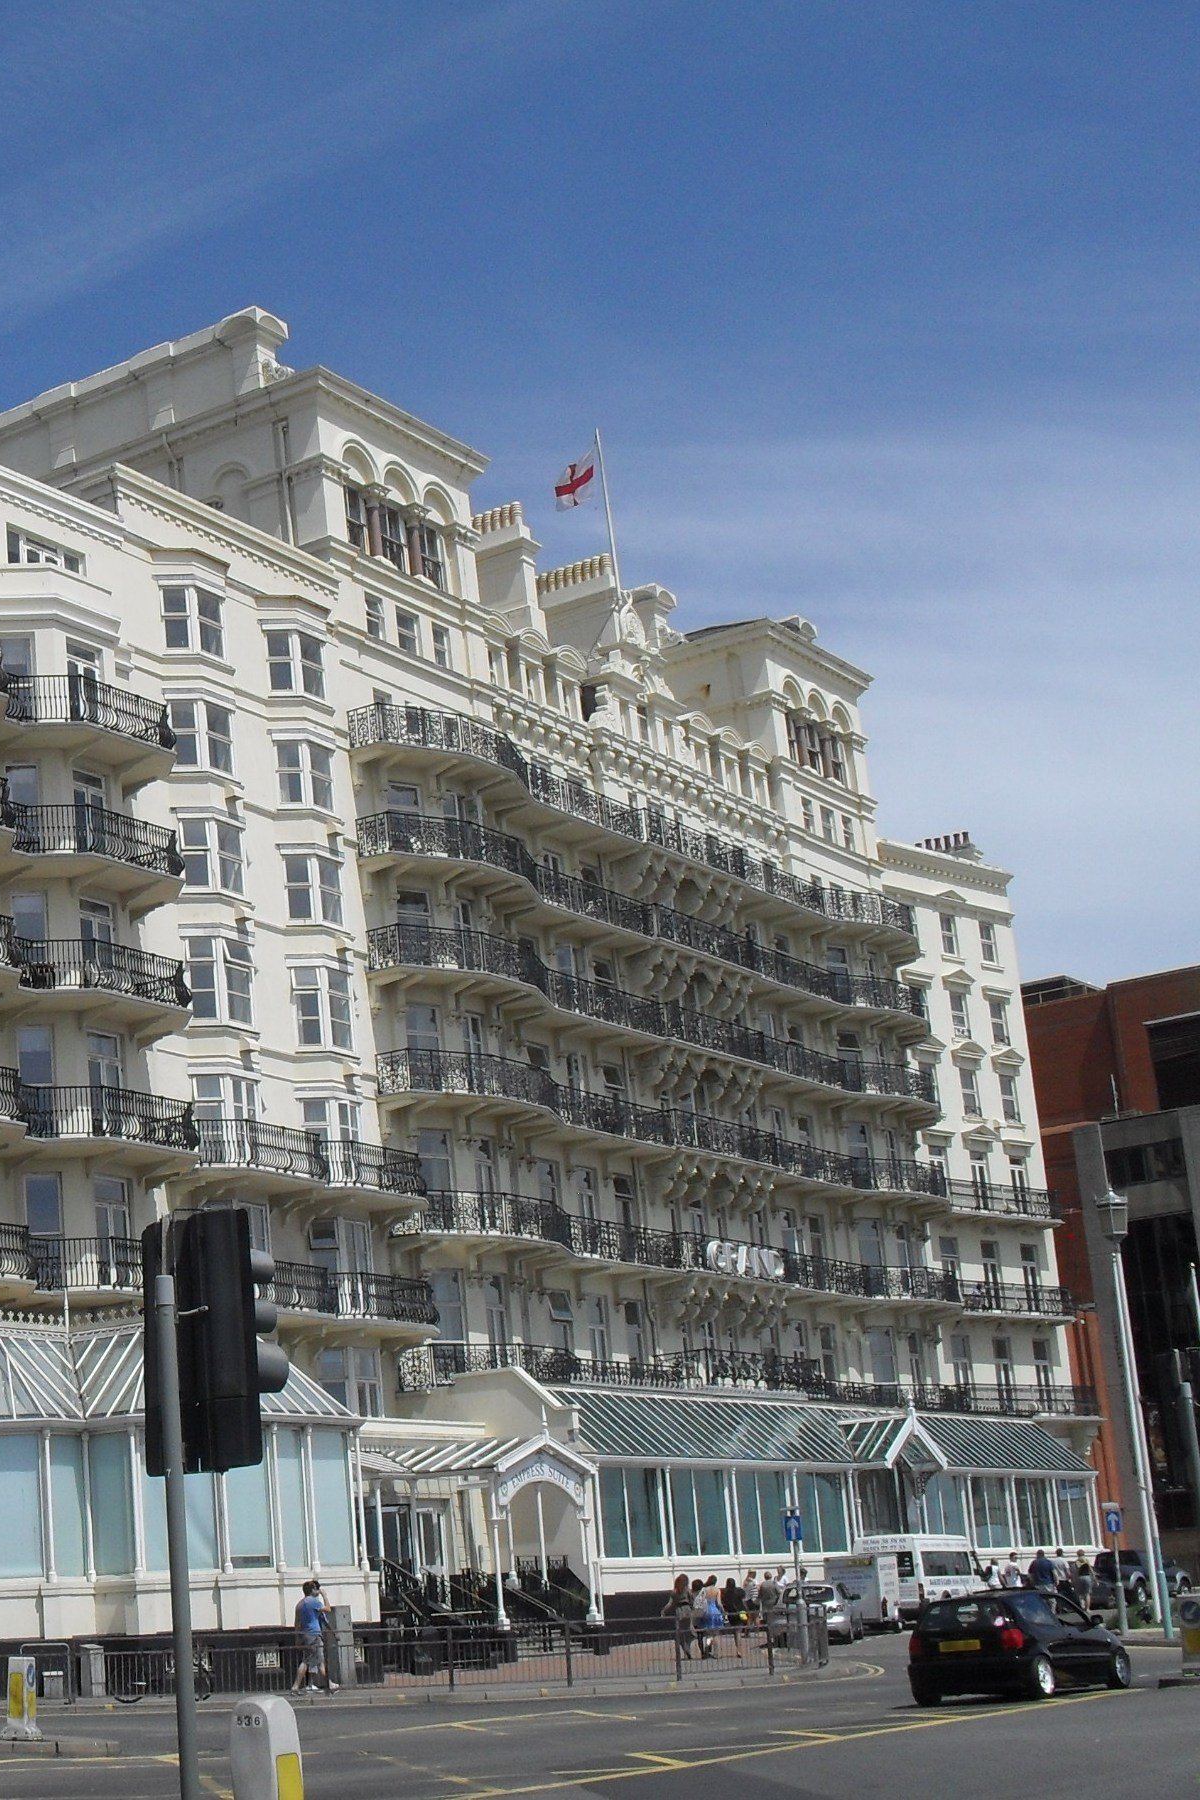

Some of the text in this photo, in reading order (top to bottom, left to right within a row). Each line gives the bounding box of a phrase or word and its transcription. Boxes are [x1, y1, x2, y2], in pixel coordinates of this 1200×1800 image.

[706, 1240, 784, 1279] GRAND
[512, 1463, 570, 1489] EMPRESS SUITE
[236, 1715, 261, 1727] 536
